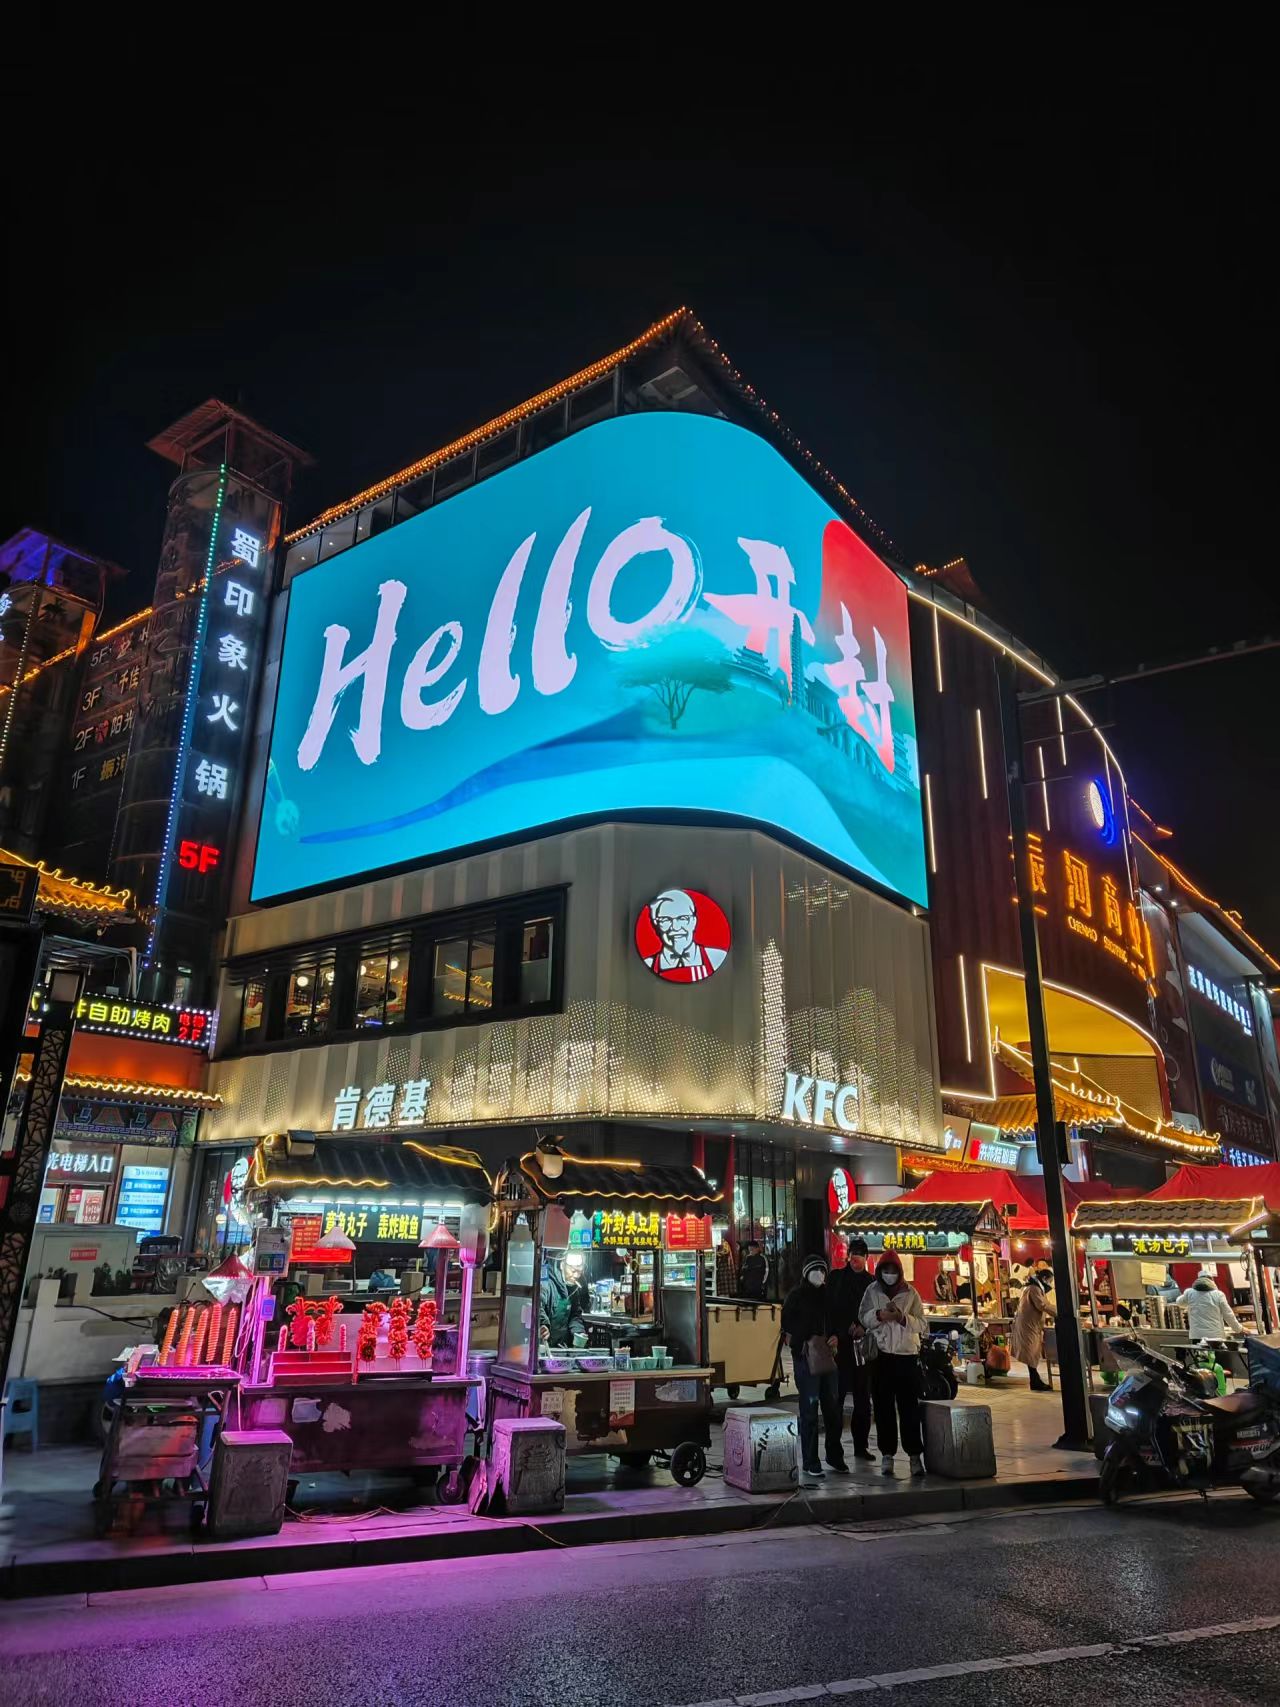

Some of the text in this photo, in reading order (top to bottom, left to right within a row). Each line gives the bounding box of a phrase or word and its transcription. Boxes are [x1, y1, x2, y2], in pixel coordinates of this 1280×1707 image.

[90, 646, 108, 668] 5F
[196, 527, 262, 801] 蜀印象火锅
[703, 536, 895, 774] 开封
[82, 687, 102, 711] 3F
[74, 726, 94, 752] 2F
[72, 765, 87, 790] 1F
[179, 840, 220, 874] 5F
[177, 1026, 202, 1042] 2F
[332, 1079, 431, 1131] 肯德基
[782, 1071, 860, 1132] KFC
[601, 1209, 660, 1236] 开封臭豆腐
[1133, 1238, 1189, 1254] 灌汤包子
